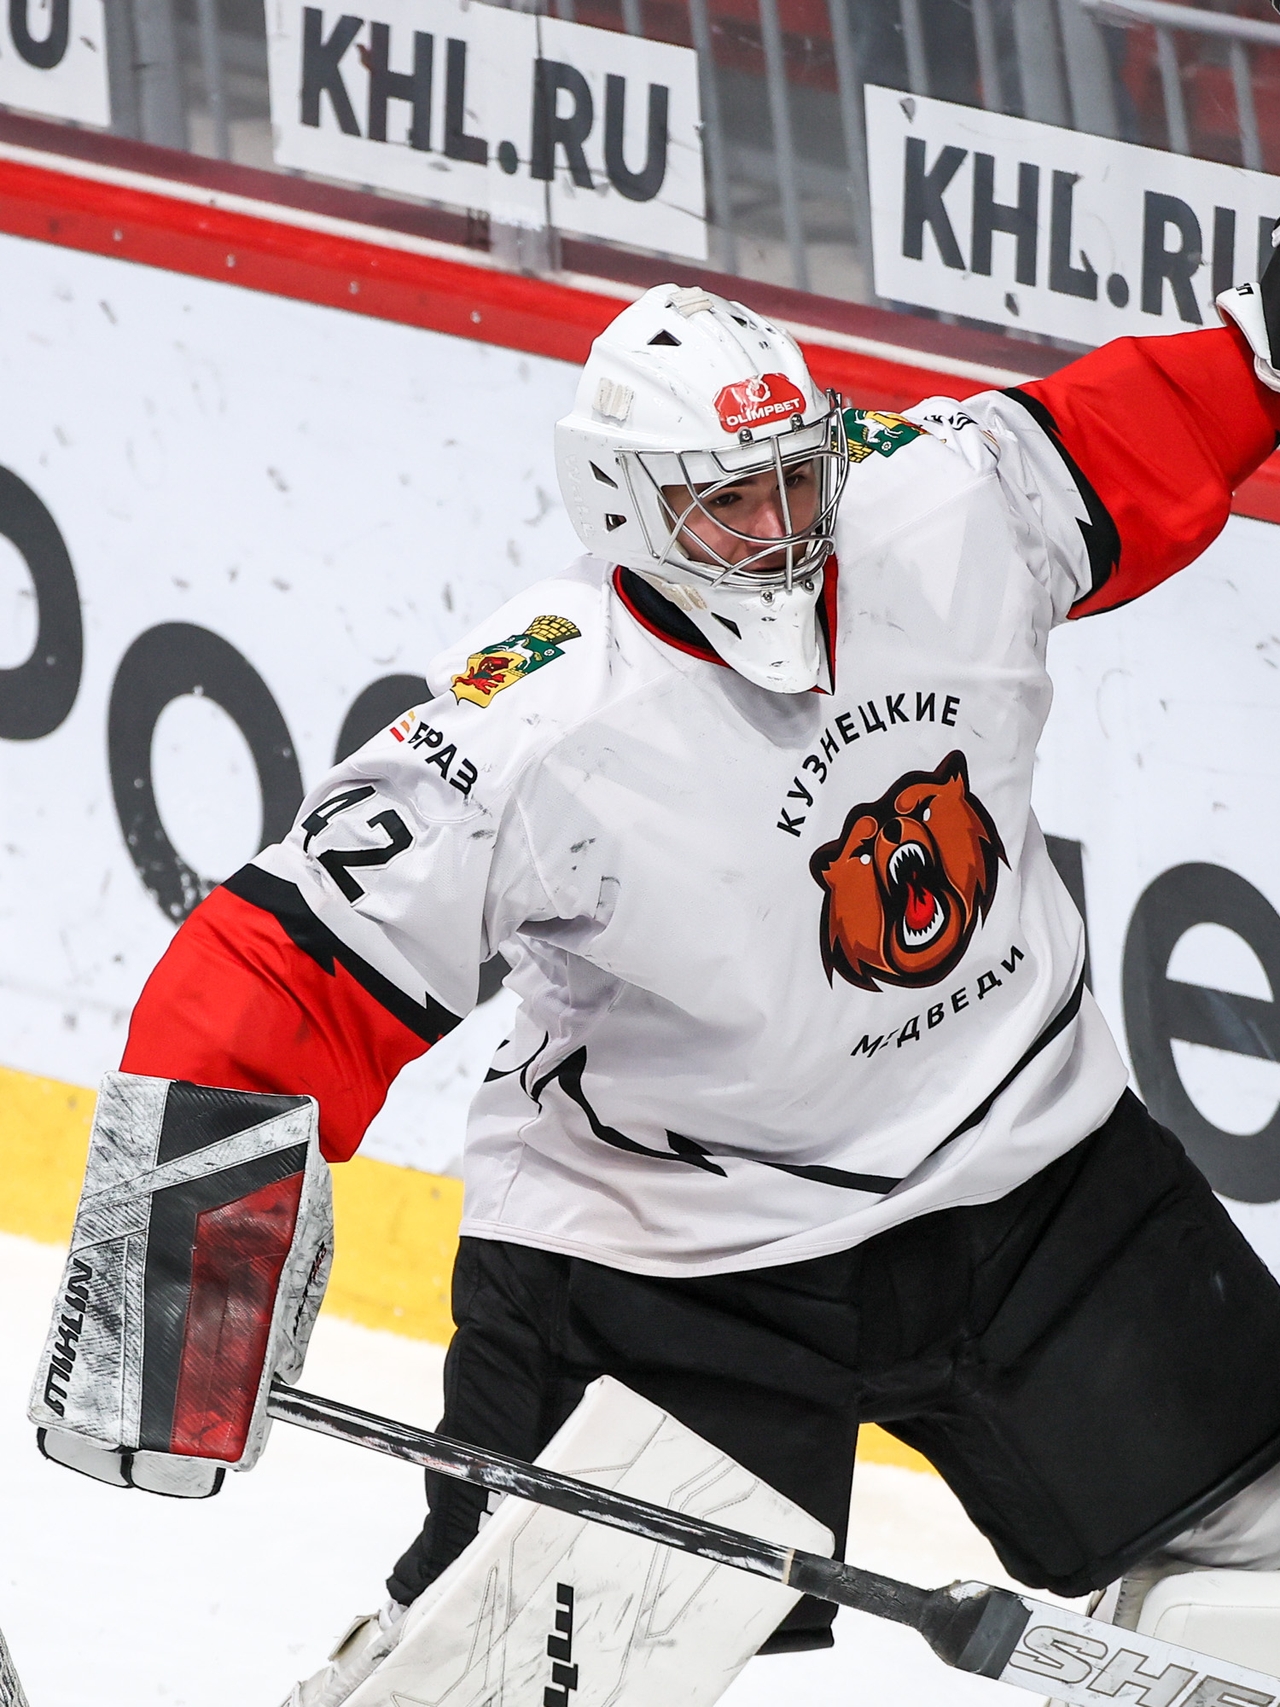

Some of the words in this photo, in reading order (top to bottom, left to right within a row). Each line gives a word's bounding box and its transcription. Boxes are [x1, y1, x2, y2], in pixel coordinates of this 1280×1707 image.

[300, 6, 669, 203] KHL.RU
[726, 398, 801, 427] OLIMPBET
[775, 691, 961, 838] КУЗНЕЦКИЕ
[300, 784, 414, 905] 42
[850, 945, 1025, 1059] МДВЕДИ
